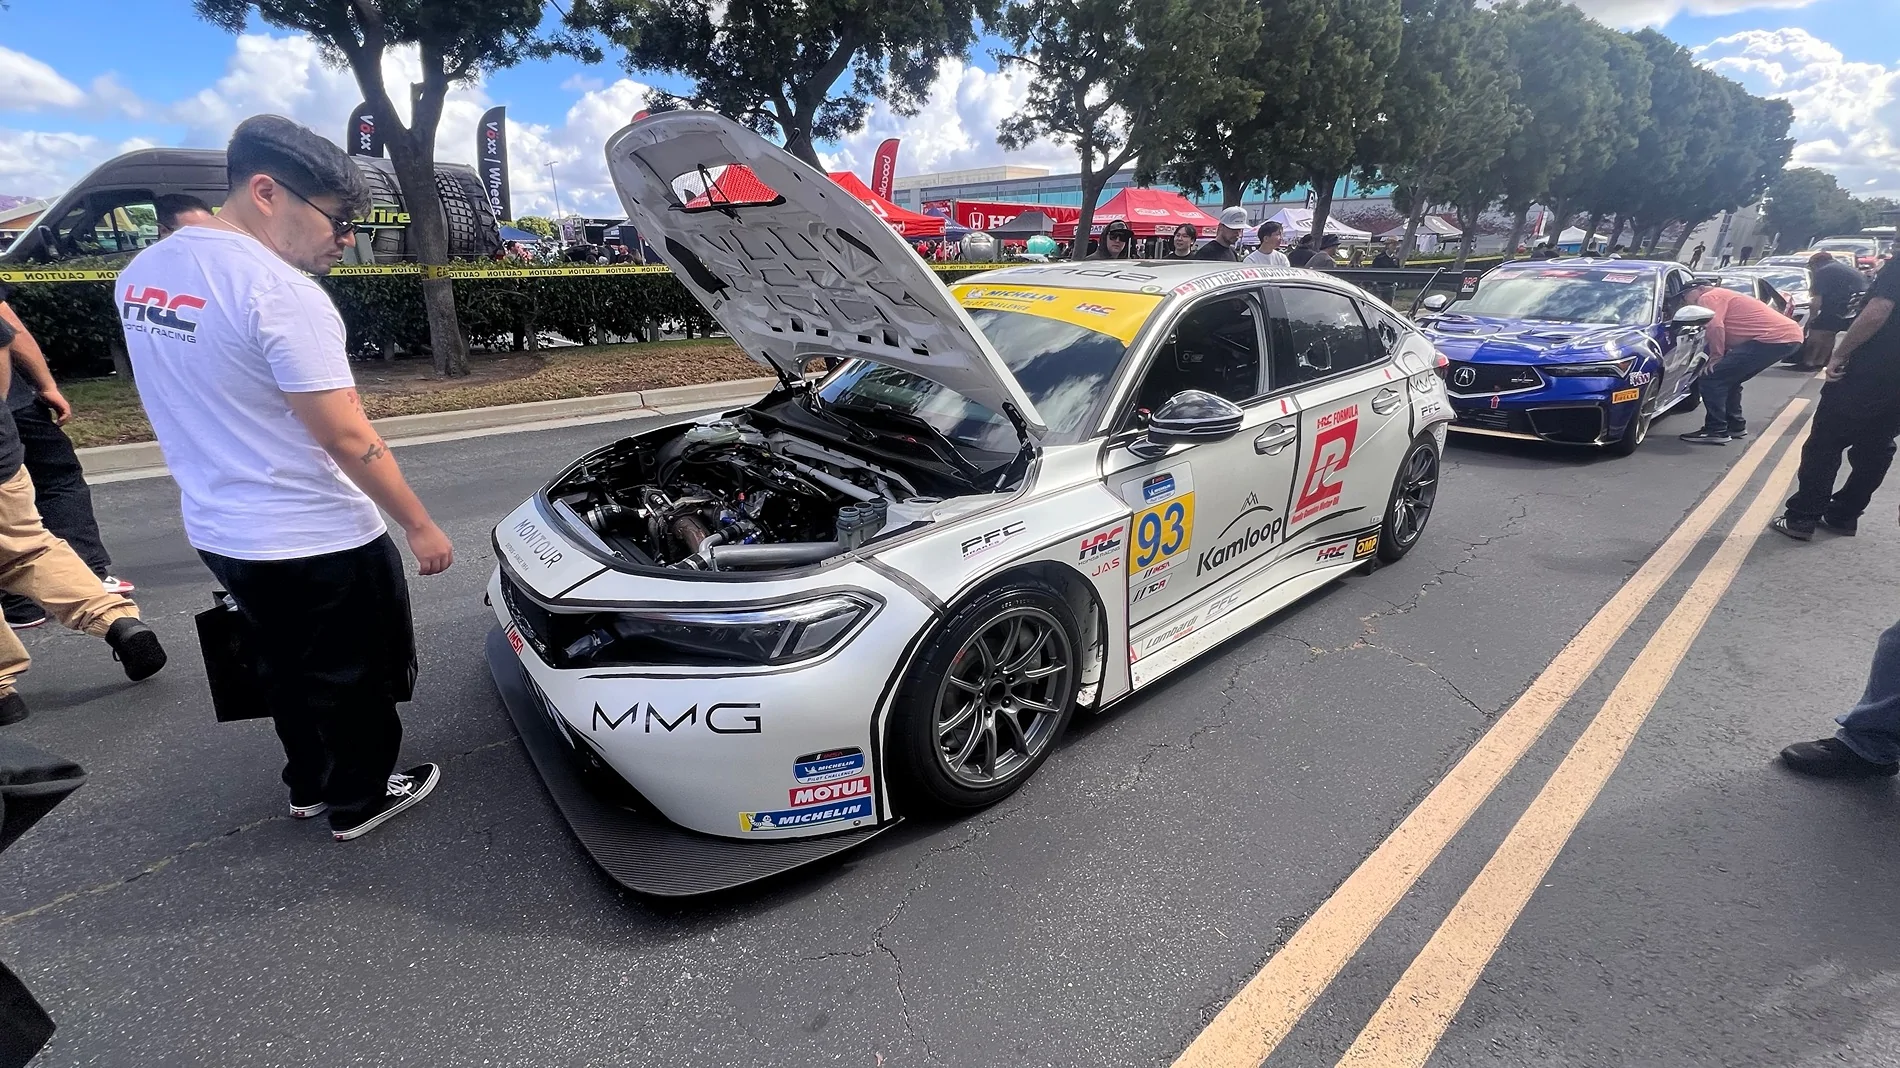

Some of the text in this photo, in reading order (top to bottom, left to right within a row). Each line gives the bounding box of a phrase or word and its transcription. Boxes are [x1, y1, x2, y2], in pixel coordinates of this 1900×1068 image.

[489, 167, 502, 217] Wheels
[1193, 269, 1245, 291] WITTMER
[123, 284, 208, 333] HRC
[986, 290, 1058, 302] MICHELIN
[1076, 302, 1116, 315] HRC
[150, 326, 197, 344] RACING
[1317, 404, 1359, 430] HRC FORMULA
[1420, 401, 1441, 416] PFC
[513, 518, 563, 569] MONTOUR
[961, 520, 1027, 554] PFC
[1078, 525, 1124, 561] HRC
[1136, 502, 1185, 568] 93
[1196, 517, 1282, 577] Kamloop
[1356, 537, 1377, 554] OMP
[1316, 543, 1349, 562] HRC
[1091, 557, 1121, 577] JAS
[1148, 579, 1166, 594] TCR
[1207, 589, 1242, 615] PFC
[508, 629, 524, 656] IMSA
[1145, 615, 1199, 650] Lombardi
[592, 701, 762, 734] MMG
[806, 770, 855, 782] PILOT CHALLENGE
[817, 760, 855, 771] MICHELIN
[794, 779, 868, 805] MOTUL
[778, 804, 862, 825] MICHELIN
